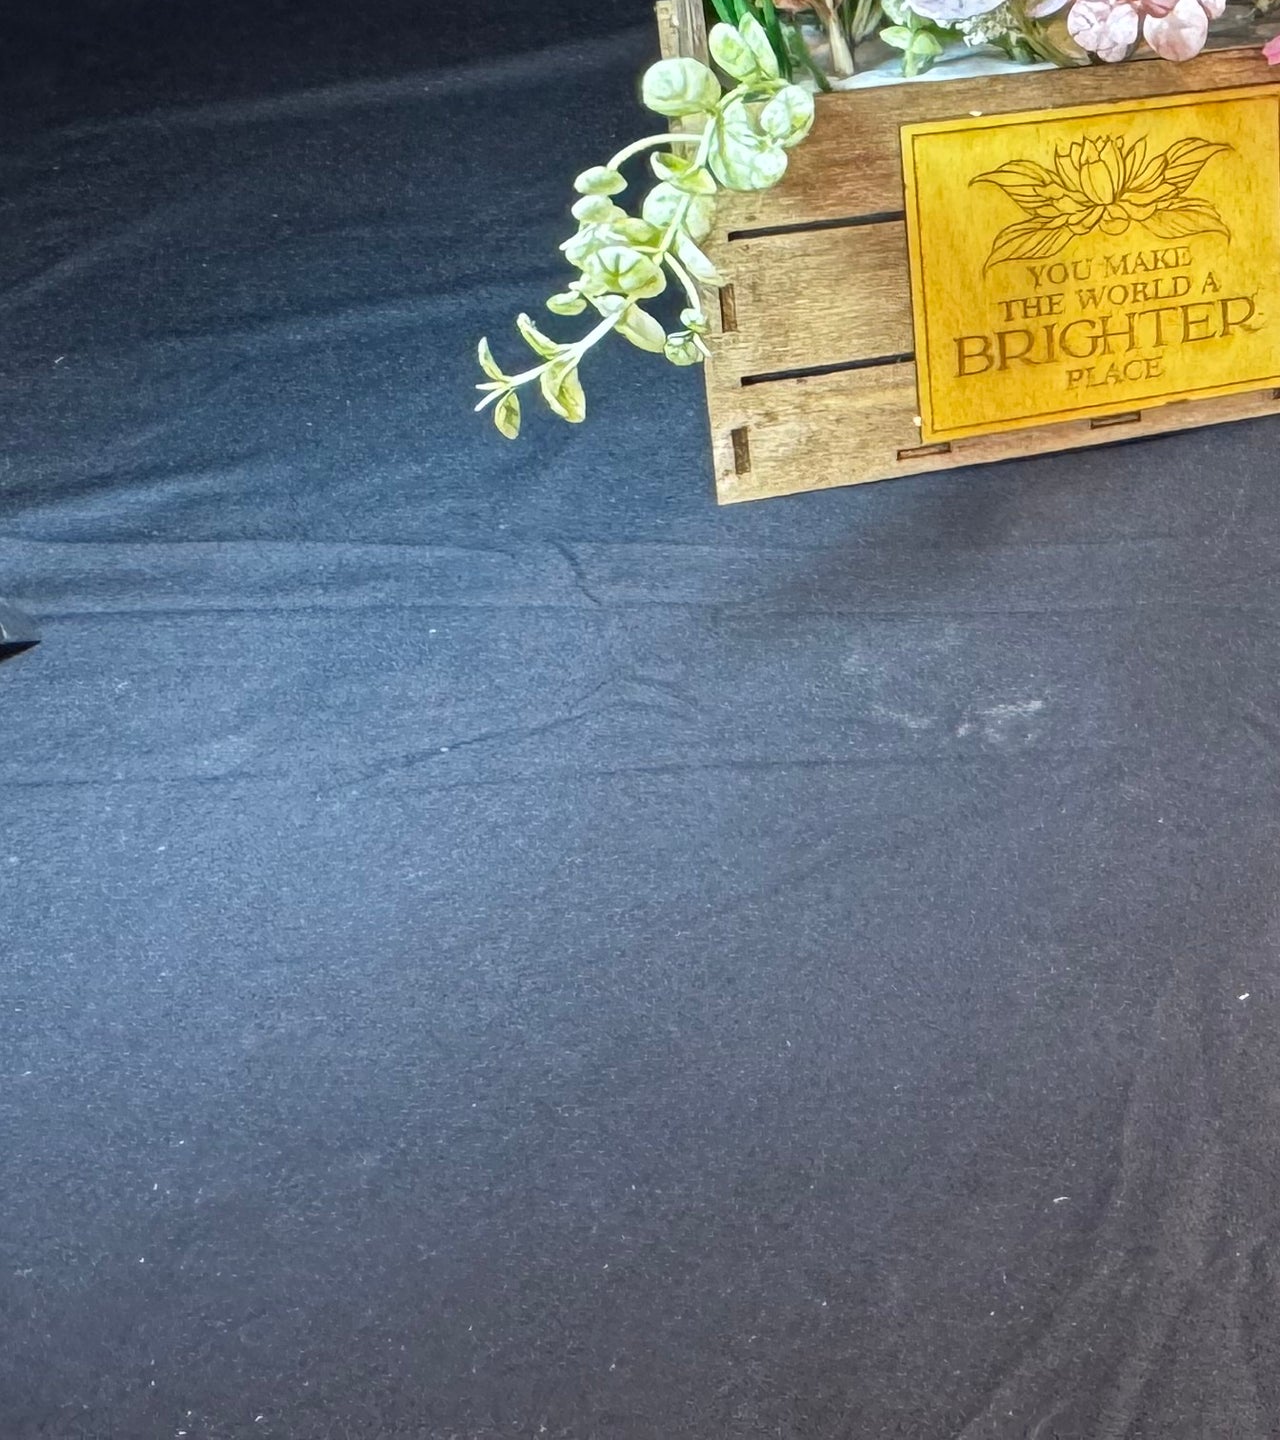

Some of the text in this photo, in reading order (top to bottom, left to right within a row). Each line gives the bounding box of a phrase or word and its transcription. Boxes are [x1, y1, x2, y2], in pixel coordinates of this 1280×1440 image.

[1027, 246, 1194, 289] YOU MAKE
[998, 271, 1222, 323] THE WORLD A
[953, 294, 1264, 378] BRIGHTER
[1065, 356, 1165, 392] PLACE
